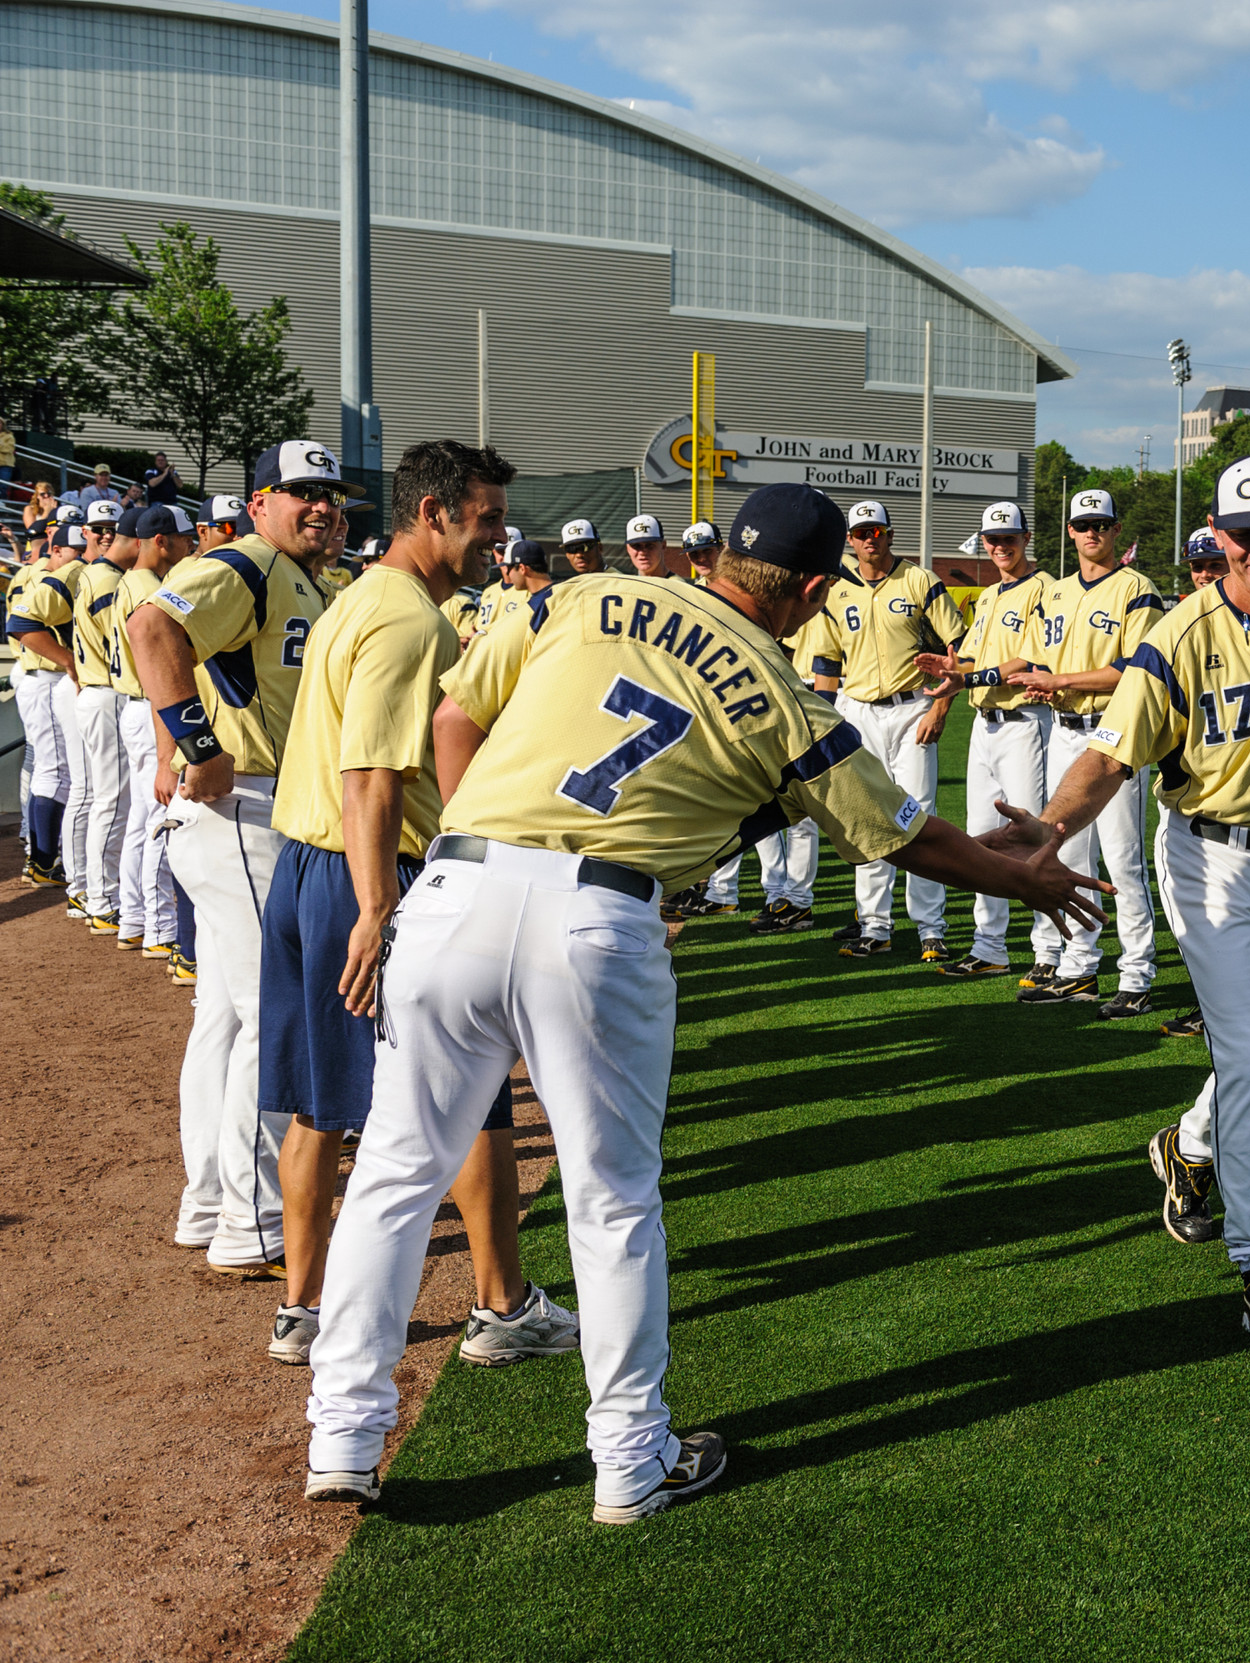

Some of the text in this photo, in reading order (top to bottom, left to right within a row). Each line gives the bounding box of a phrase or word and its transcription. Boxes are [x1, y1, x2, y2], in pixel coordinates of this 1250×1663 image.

[305, 451, 336, 474] GT
[756, 437, 994, 469] JOHN and MARY BROCK
[805, 467, 949, 492] Football Facity
[856, 506, 875, 517] GT
[1080, 495, 1101, 509] GT
[990, 510, 1010, 523] GT
[845, 605, 861, 632] 6
[888, 598, 918, 617] GT
[1002, 611, 1024, 633] GT
[1089, 611, 1121, 636] GT
[555, 673, 696, 818] 7
